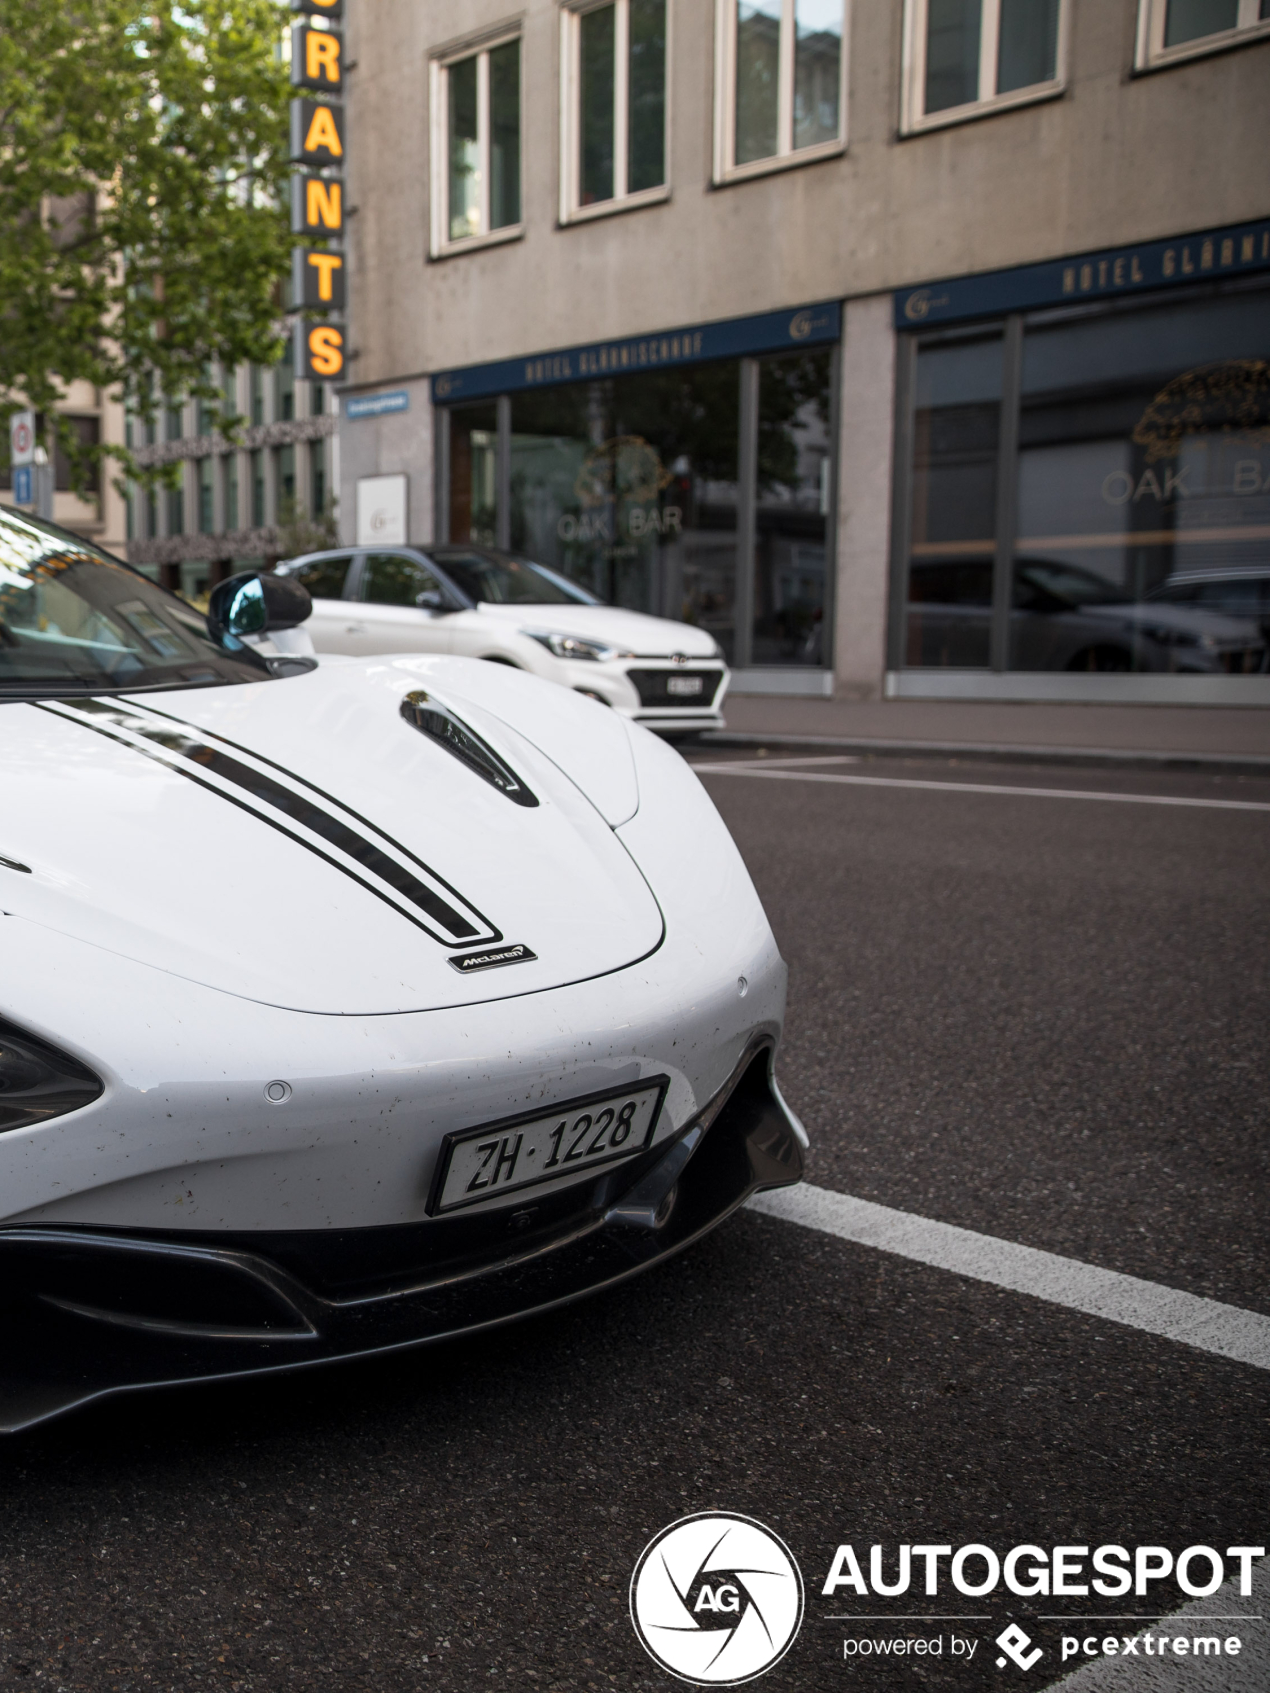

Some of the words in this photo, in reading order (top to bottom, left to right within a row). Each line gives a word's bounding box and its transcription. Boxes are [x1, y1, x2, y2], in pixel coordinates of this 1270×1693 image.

[304, 0, 343, 376] RANTS
[1063, 254, 1144, 295] HOTEL
[1101, 465, 1191, 506] OAK
[557, 511, 610, 542] OAK
[628, 505, 683, 537] BAR
[462, 948, 523, 967] McLaren
